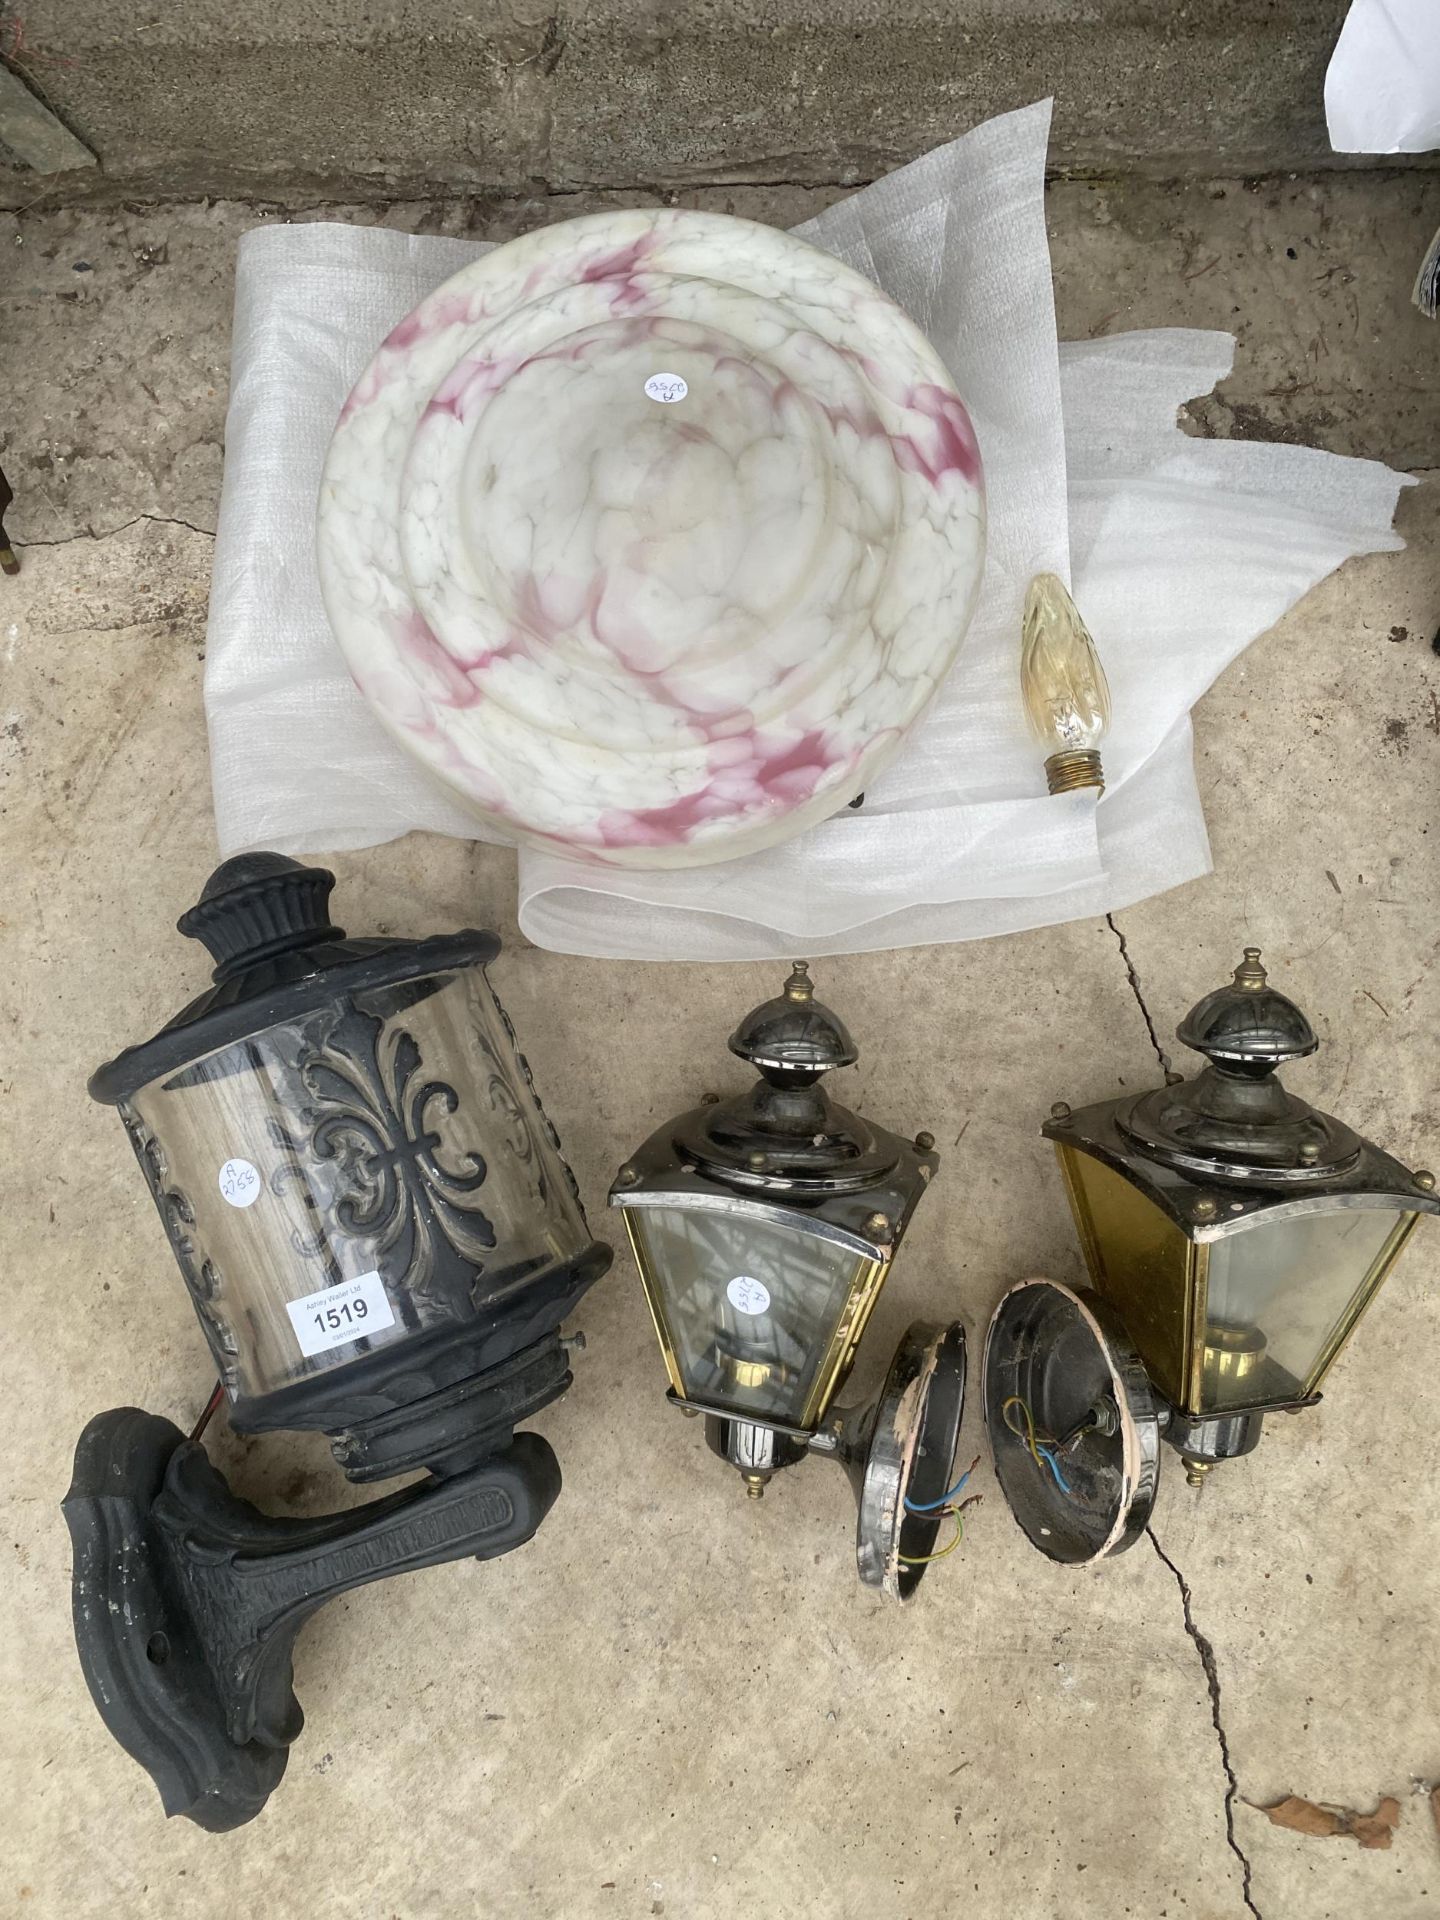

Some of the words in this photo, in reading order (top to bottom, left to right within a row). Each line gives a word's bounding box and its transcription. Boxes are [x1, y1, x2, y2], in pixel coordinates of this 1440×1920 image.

[226, 1163, 236, 1178] A
[306, 1296, 327, 1310] Ashley
[328, 1290, 349, 1302] Waller
[350, 1285, 361, 1294] Ltd
[314, 1298, 368, 1333] 1519
